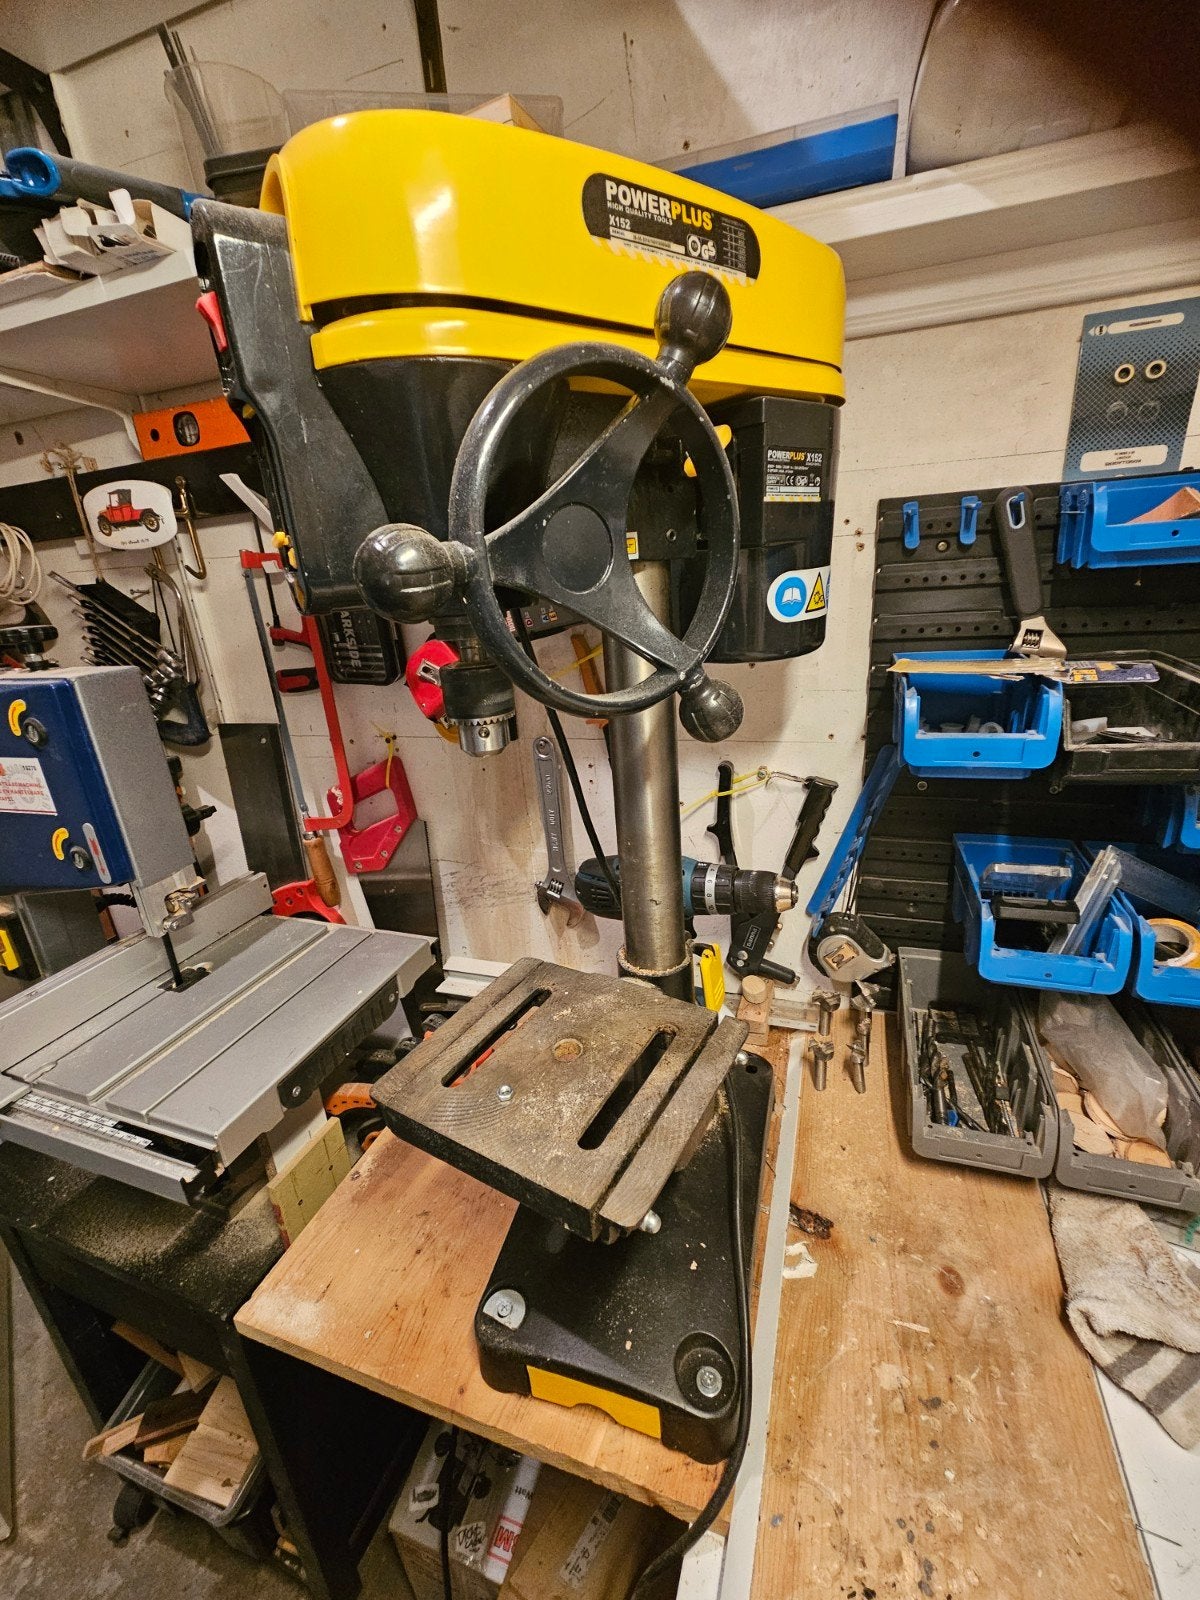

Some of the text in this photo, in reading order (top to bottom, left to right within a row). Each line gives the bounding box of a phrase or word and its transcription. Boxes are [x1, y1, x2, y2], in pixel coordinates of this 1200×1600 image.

[605, 179, 713, 231] POWERPLUS
[607, 201, 673, 226] HIGH QUALITY TOOLS
[608, 214, 631, 231] X152
[767, 449, 823, 463] POWERPLUS X152
[340, 610, 362, 668] ARKSIDE
